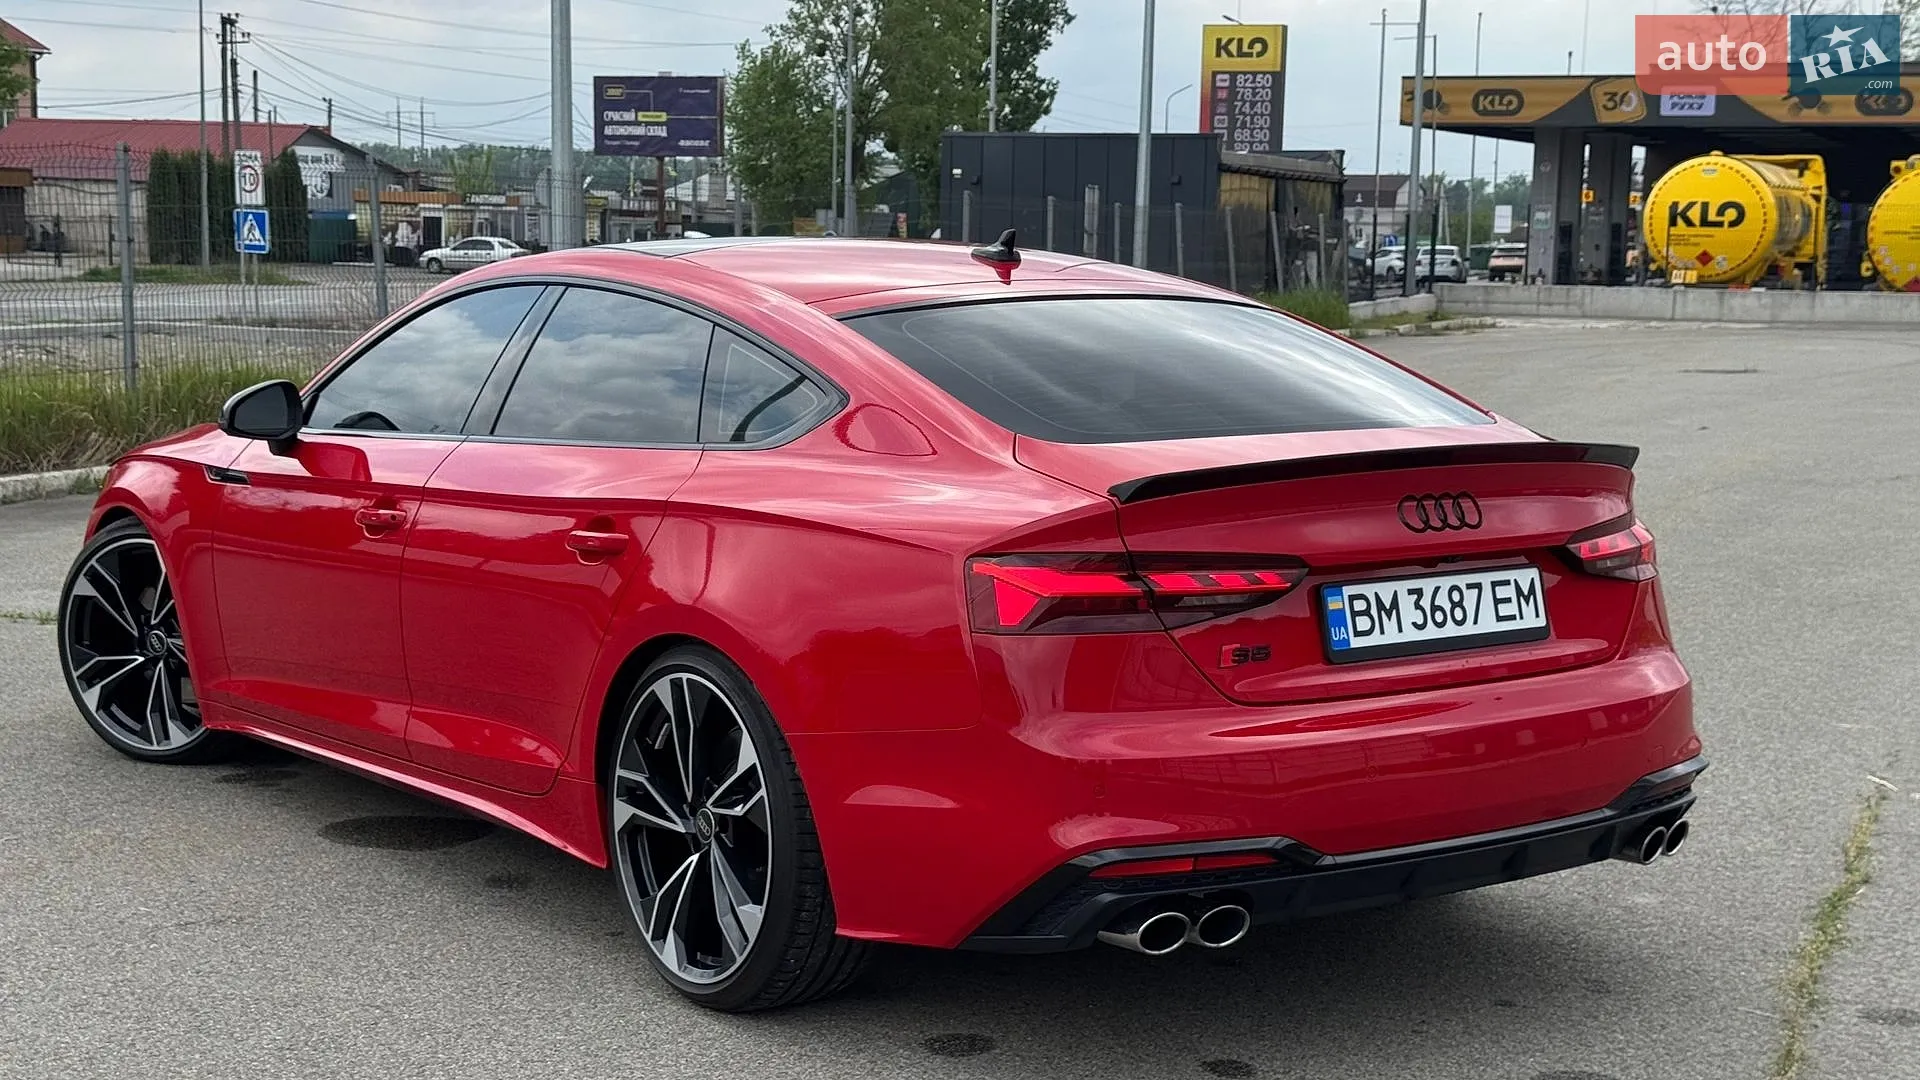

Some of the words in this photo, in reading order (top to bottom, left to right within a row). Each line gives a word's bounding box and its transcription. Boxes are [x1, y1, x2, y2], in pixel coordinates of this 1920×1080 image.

[1215, 37, 1269, 58] KLO
[1236, 74, 1272, 87] 82.50
[1236, 88, 1272, 101] 78.20
[1602, 91, 1637, 112] 30
[1234, 102, 1272, 115] 74.40
[1478, 94, 1519, 111] KLO
[1235, 115, 1271, 129] 71.90
[1234, 129, 1270, 142] 68.90
[241, 172, 256, 187] 10
[1668, 201, 1746, 228] KLO
[1348, 589, 1404, 638] BM
[1407, 582, 1483, 631] 3687
[1490, 577, 1540, 622] EM
[1331, 626, 1348, 641] UA
[1225, 644, 1272, 667] S5
